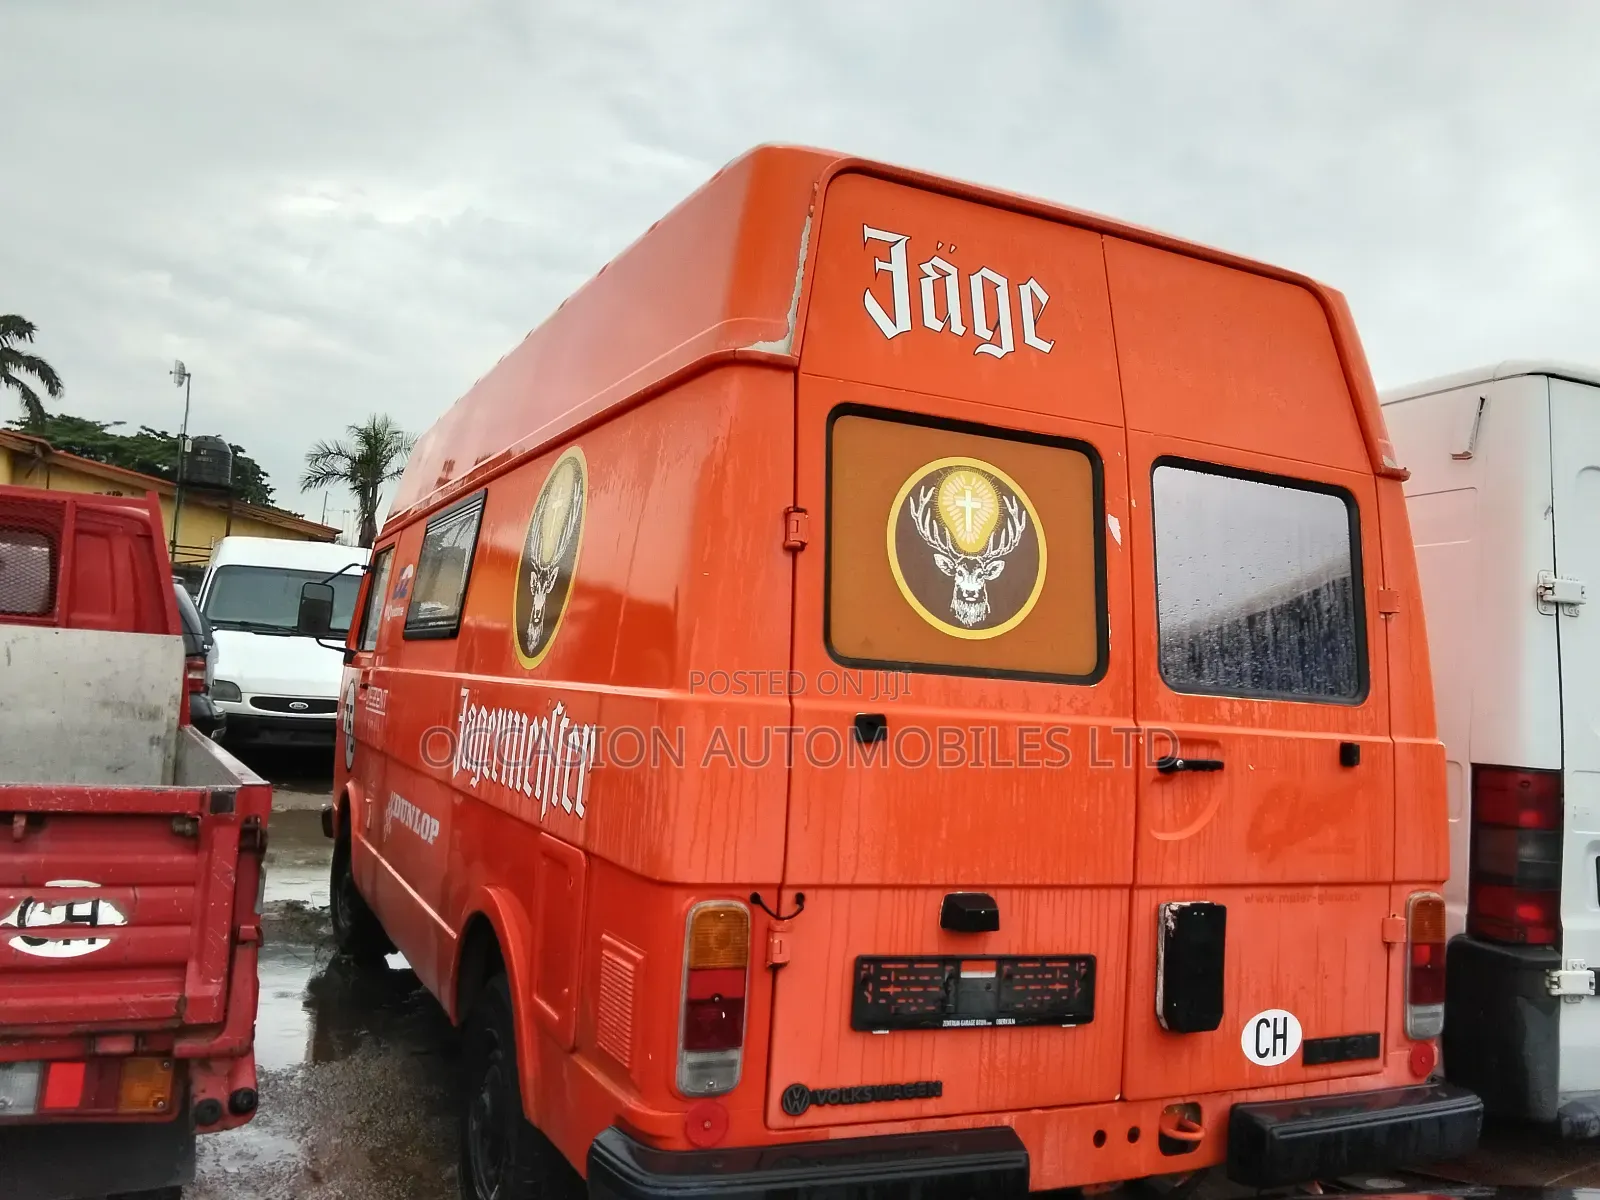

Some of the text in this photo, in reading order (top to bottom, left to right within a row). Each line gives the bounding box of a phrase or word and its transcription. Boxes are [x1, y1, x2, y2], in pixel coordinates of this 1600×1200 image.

[862, 222, 1056, 360] Jäge
[390, 793, 441, 846] DUNLOP
[1254, 1016, 1288, 1059] CH
[816, 1080, 943, 1106] VOLKSWAGEN
